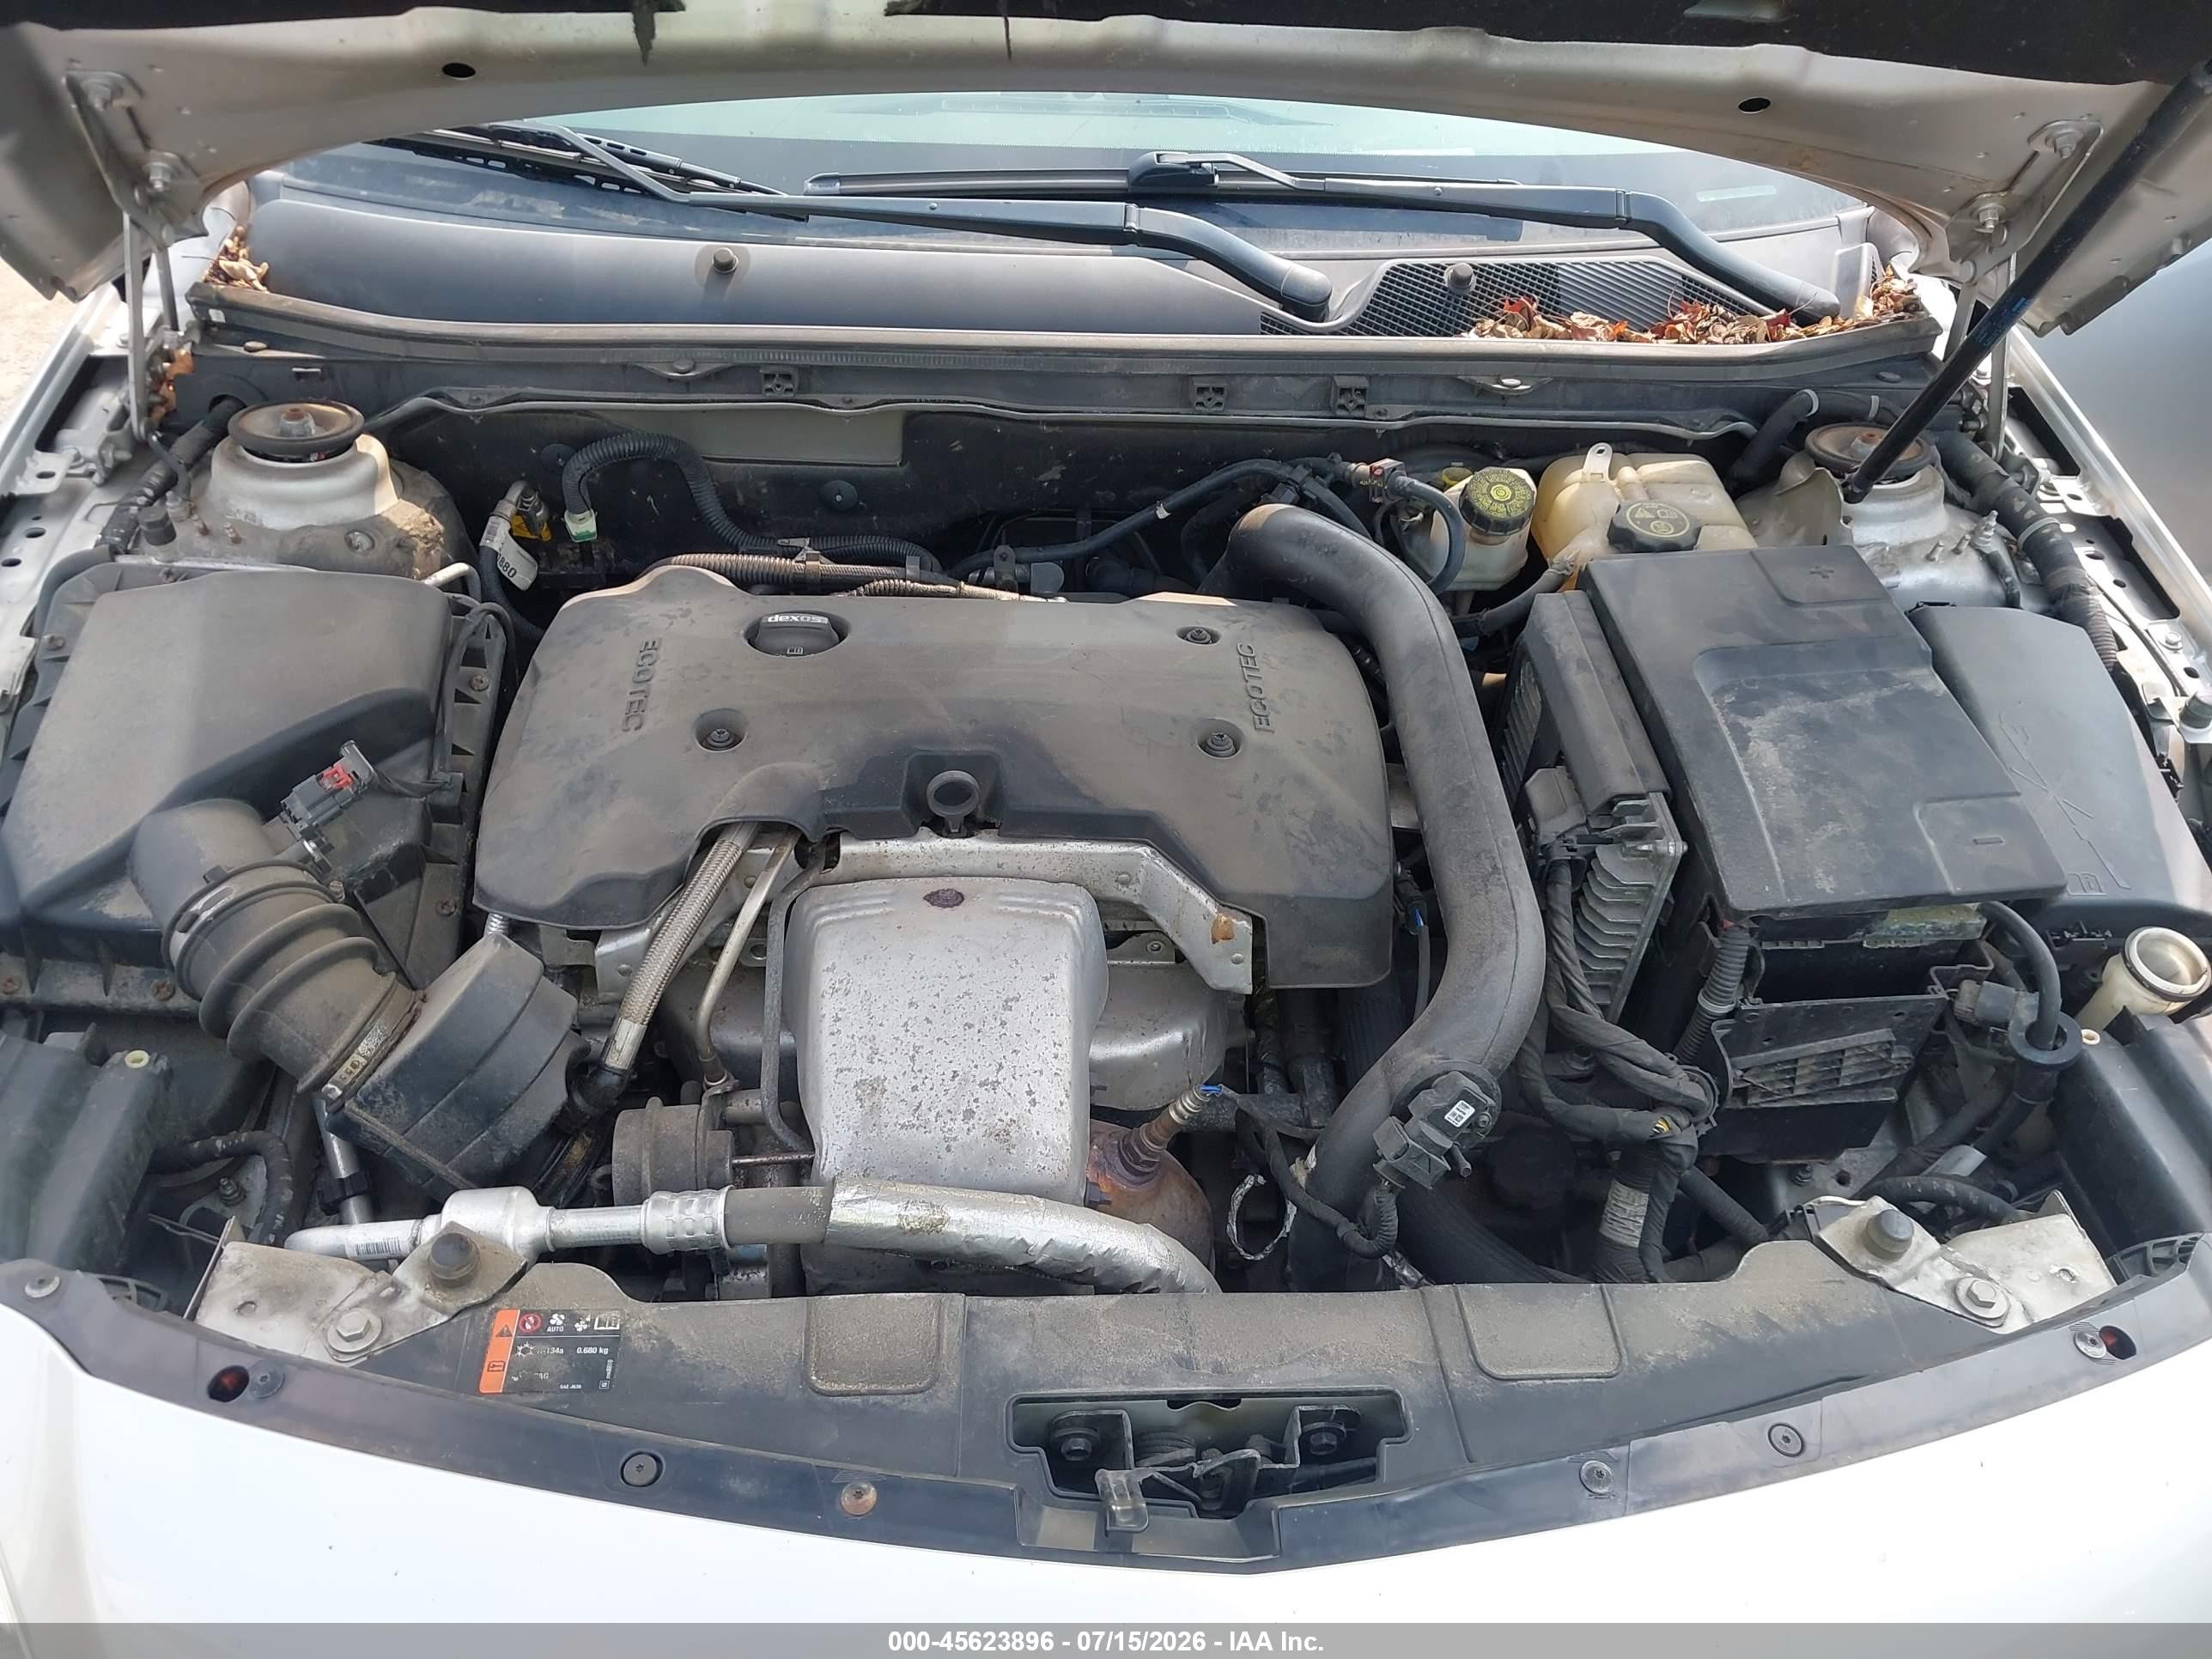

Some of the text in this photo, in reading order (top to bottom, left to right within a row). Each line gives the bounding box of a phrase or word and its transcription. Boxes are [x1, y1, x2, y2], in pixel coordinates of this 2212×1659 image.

[621, 637, 661, 732] ECOTEC
[1237, 642, 1275, 733] ECOTEC
[599, 1346, 609, 1355] kg
